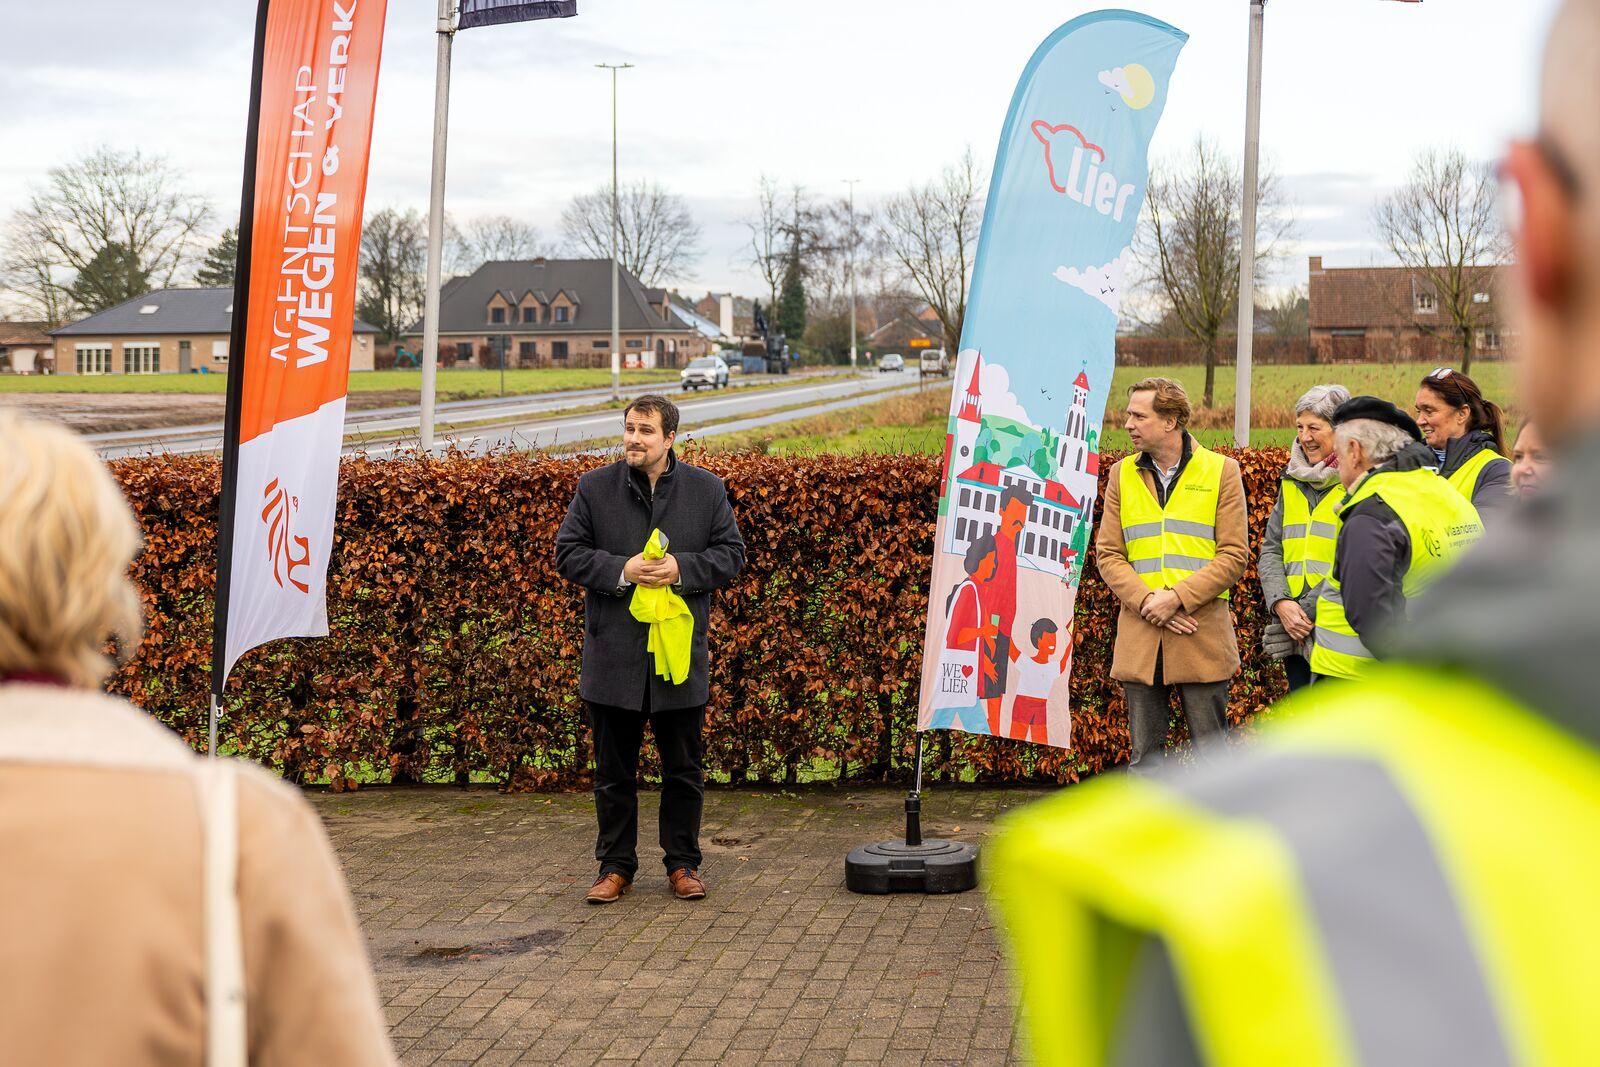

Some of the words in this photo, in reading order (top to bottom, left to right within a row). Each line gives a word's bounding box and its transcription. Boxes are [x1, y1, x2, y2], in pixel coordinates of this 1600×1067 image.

[270, 65, 318, 368] AGENTSCHAP
[1066, 146, 1136, 224] Lier
[296, 193, 337, 369] WEGEN
[322, 144, 340, 176] &
[942, 663, 961, 679] WE
[942, 678, 968, 694] LIER
